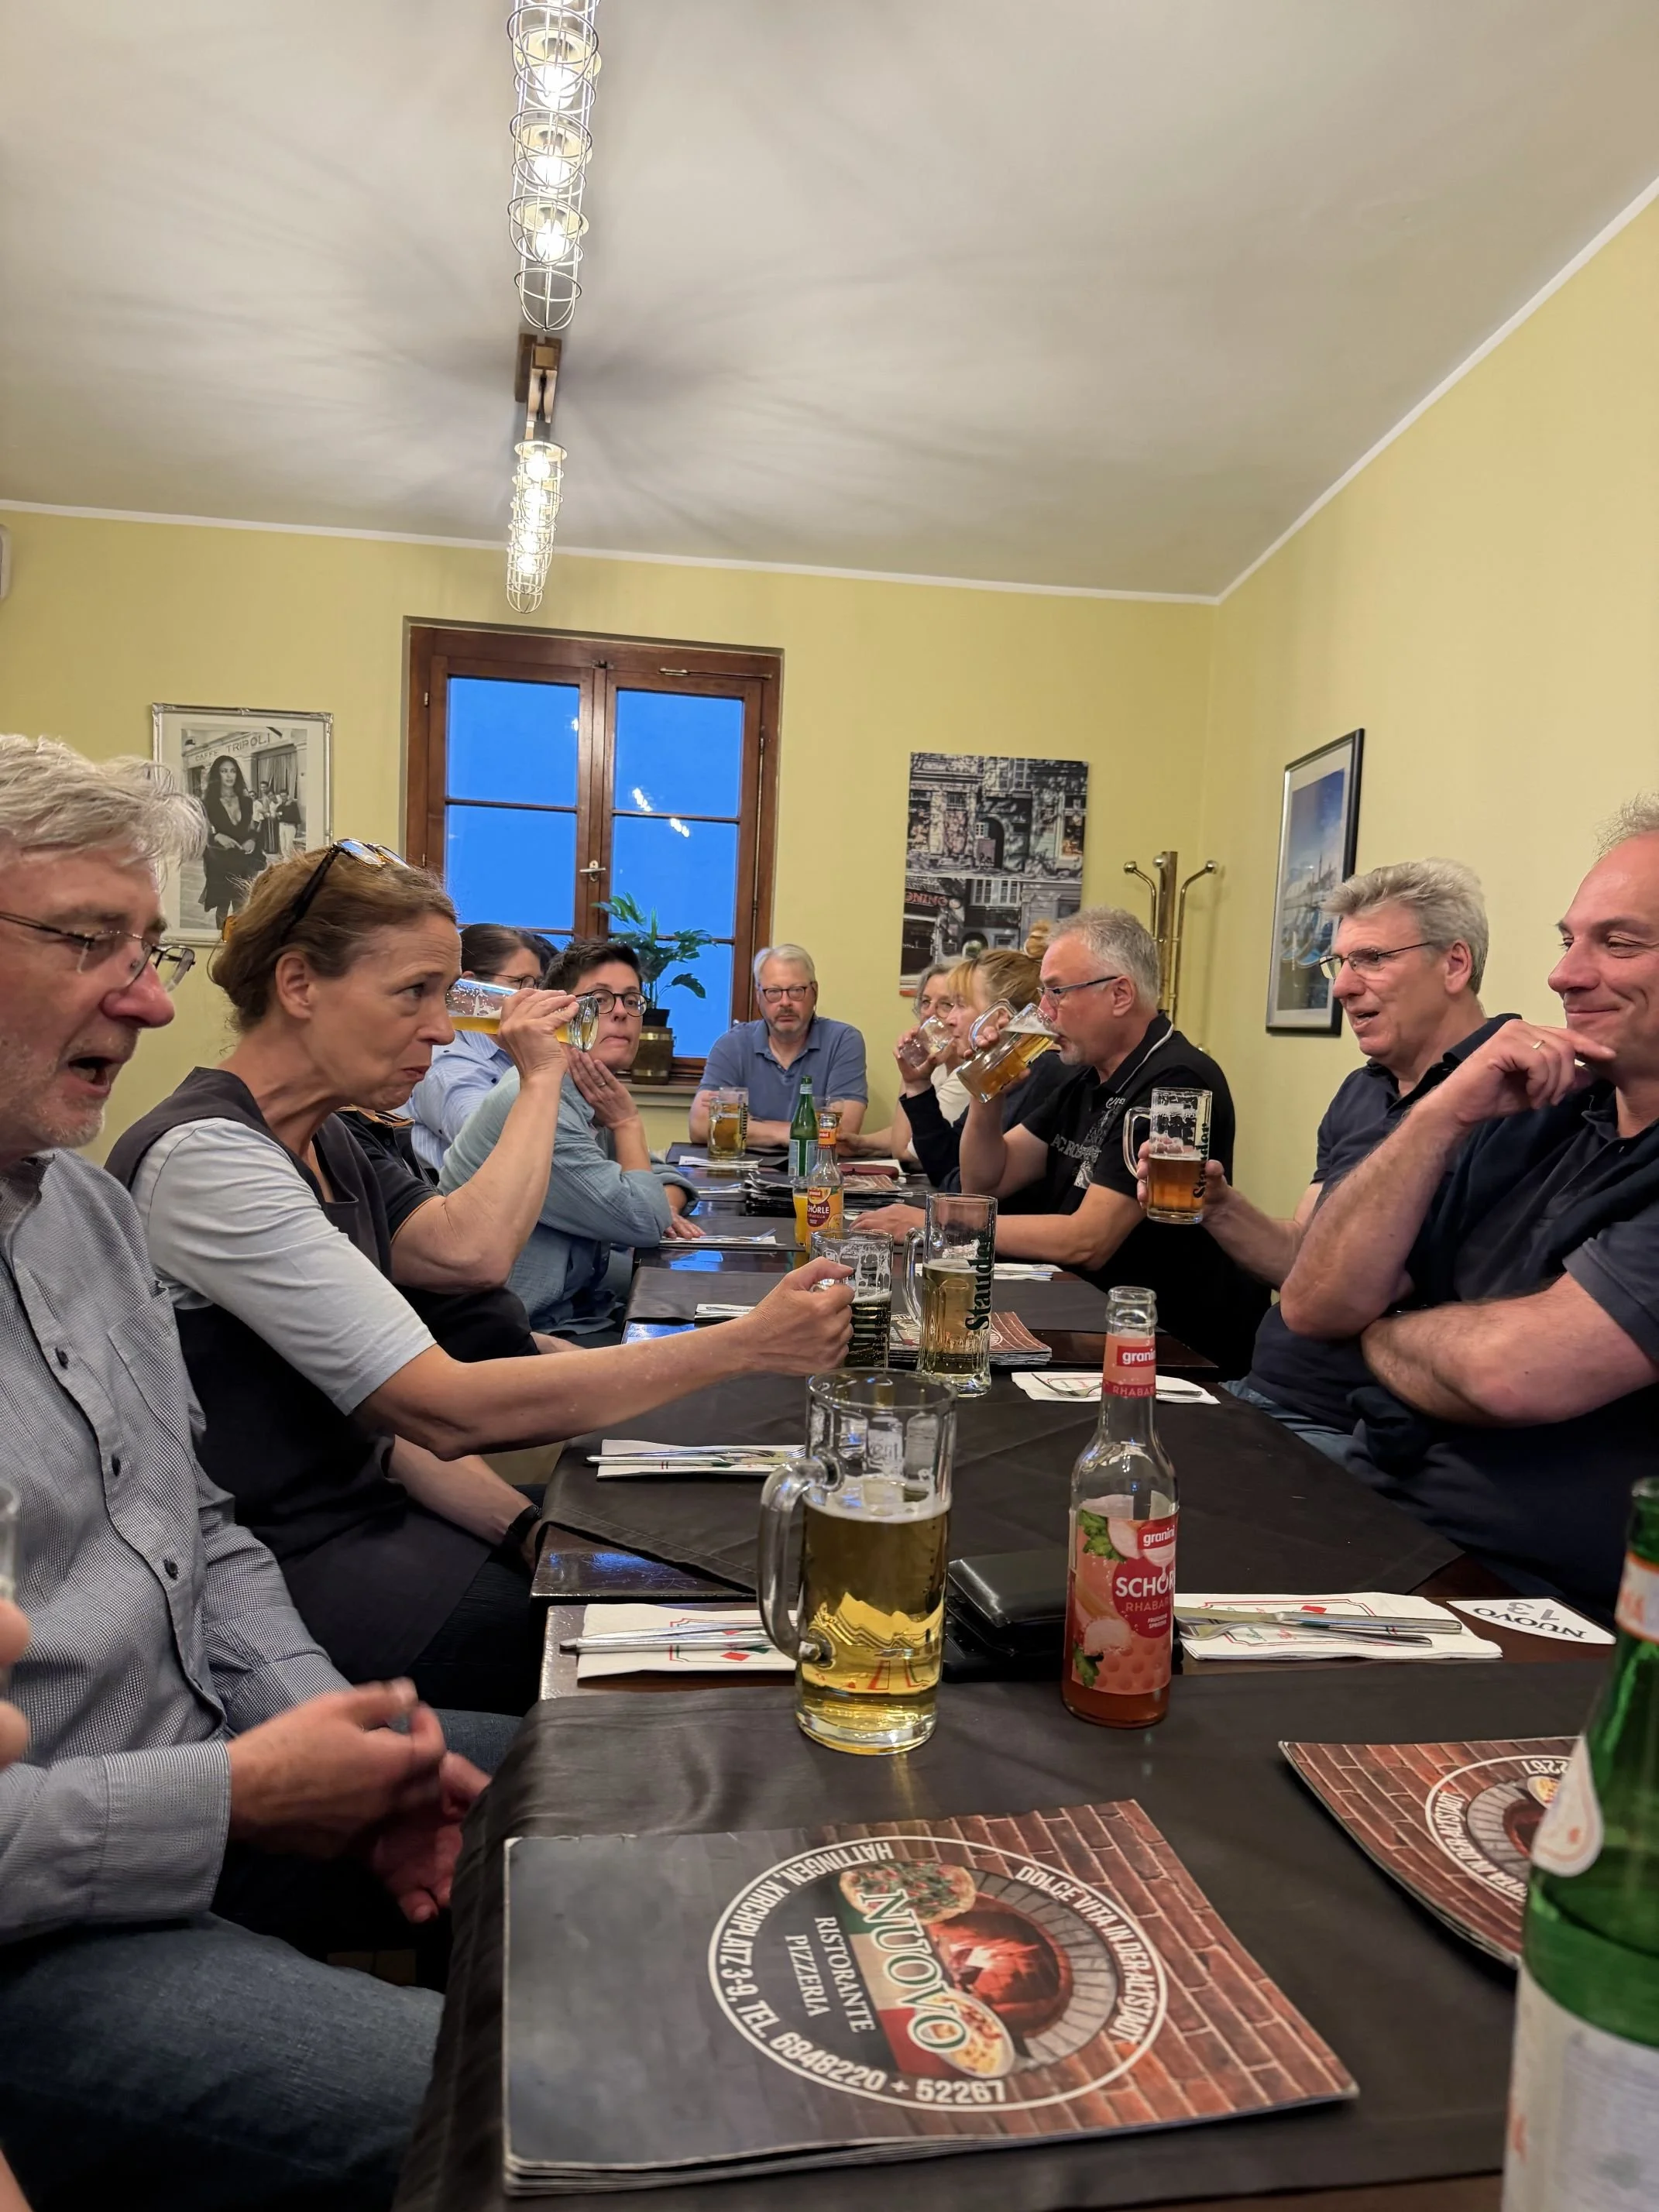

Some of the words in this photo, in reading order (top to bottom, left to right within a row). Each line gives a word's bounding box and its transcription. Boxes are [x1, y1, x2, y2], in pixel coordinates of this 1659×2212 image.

[225, 733, 270, 753] TRIPOLI
[1142, 1525, 1176, 1547] granini
[1473, 1608, 1587, 1639] NUOVO
[1506, 1602, 1560, 1621] 13
[1521, 1760, 1569, 1775] 2267
[775, 1842, 895, 1886] HATTINGEN,
[1015, 1866, 1084, 1902] DOLCE
[720, 1881, 790, 1966] KIRCHPLATZ
[1072, 1894, 1119, 1927] VITA
[1101, 1925, 1135, 1942] IN
[785, 1934, 832, 2018] PIZZERIA
[814, 1916, 876, 2032] RISTORANTE
[859, 1888, 969, 2054] NUOVO
[1113, 1942, 1152, 1976] DER
[736, 2000, 780, 2039] TEL.
[1108, 1972, 1157, 2045] ALTSTADT
[769, 2032, 888, 2091] 6848220
[915, 2078, 1006, 2104] 52267
